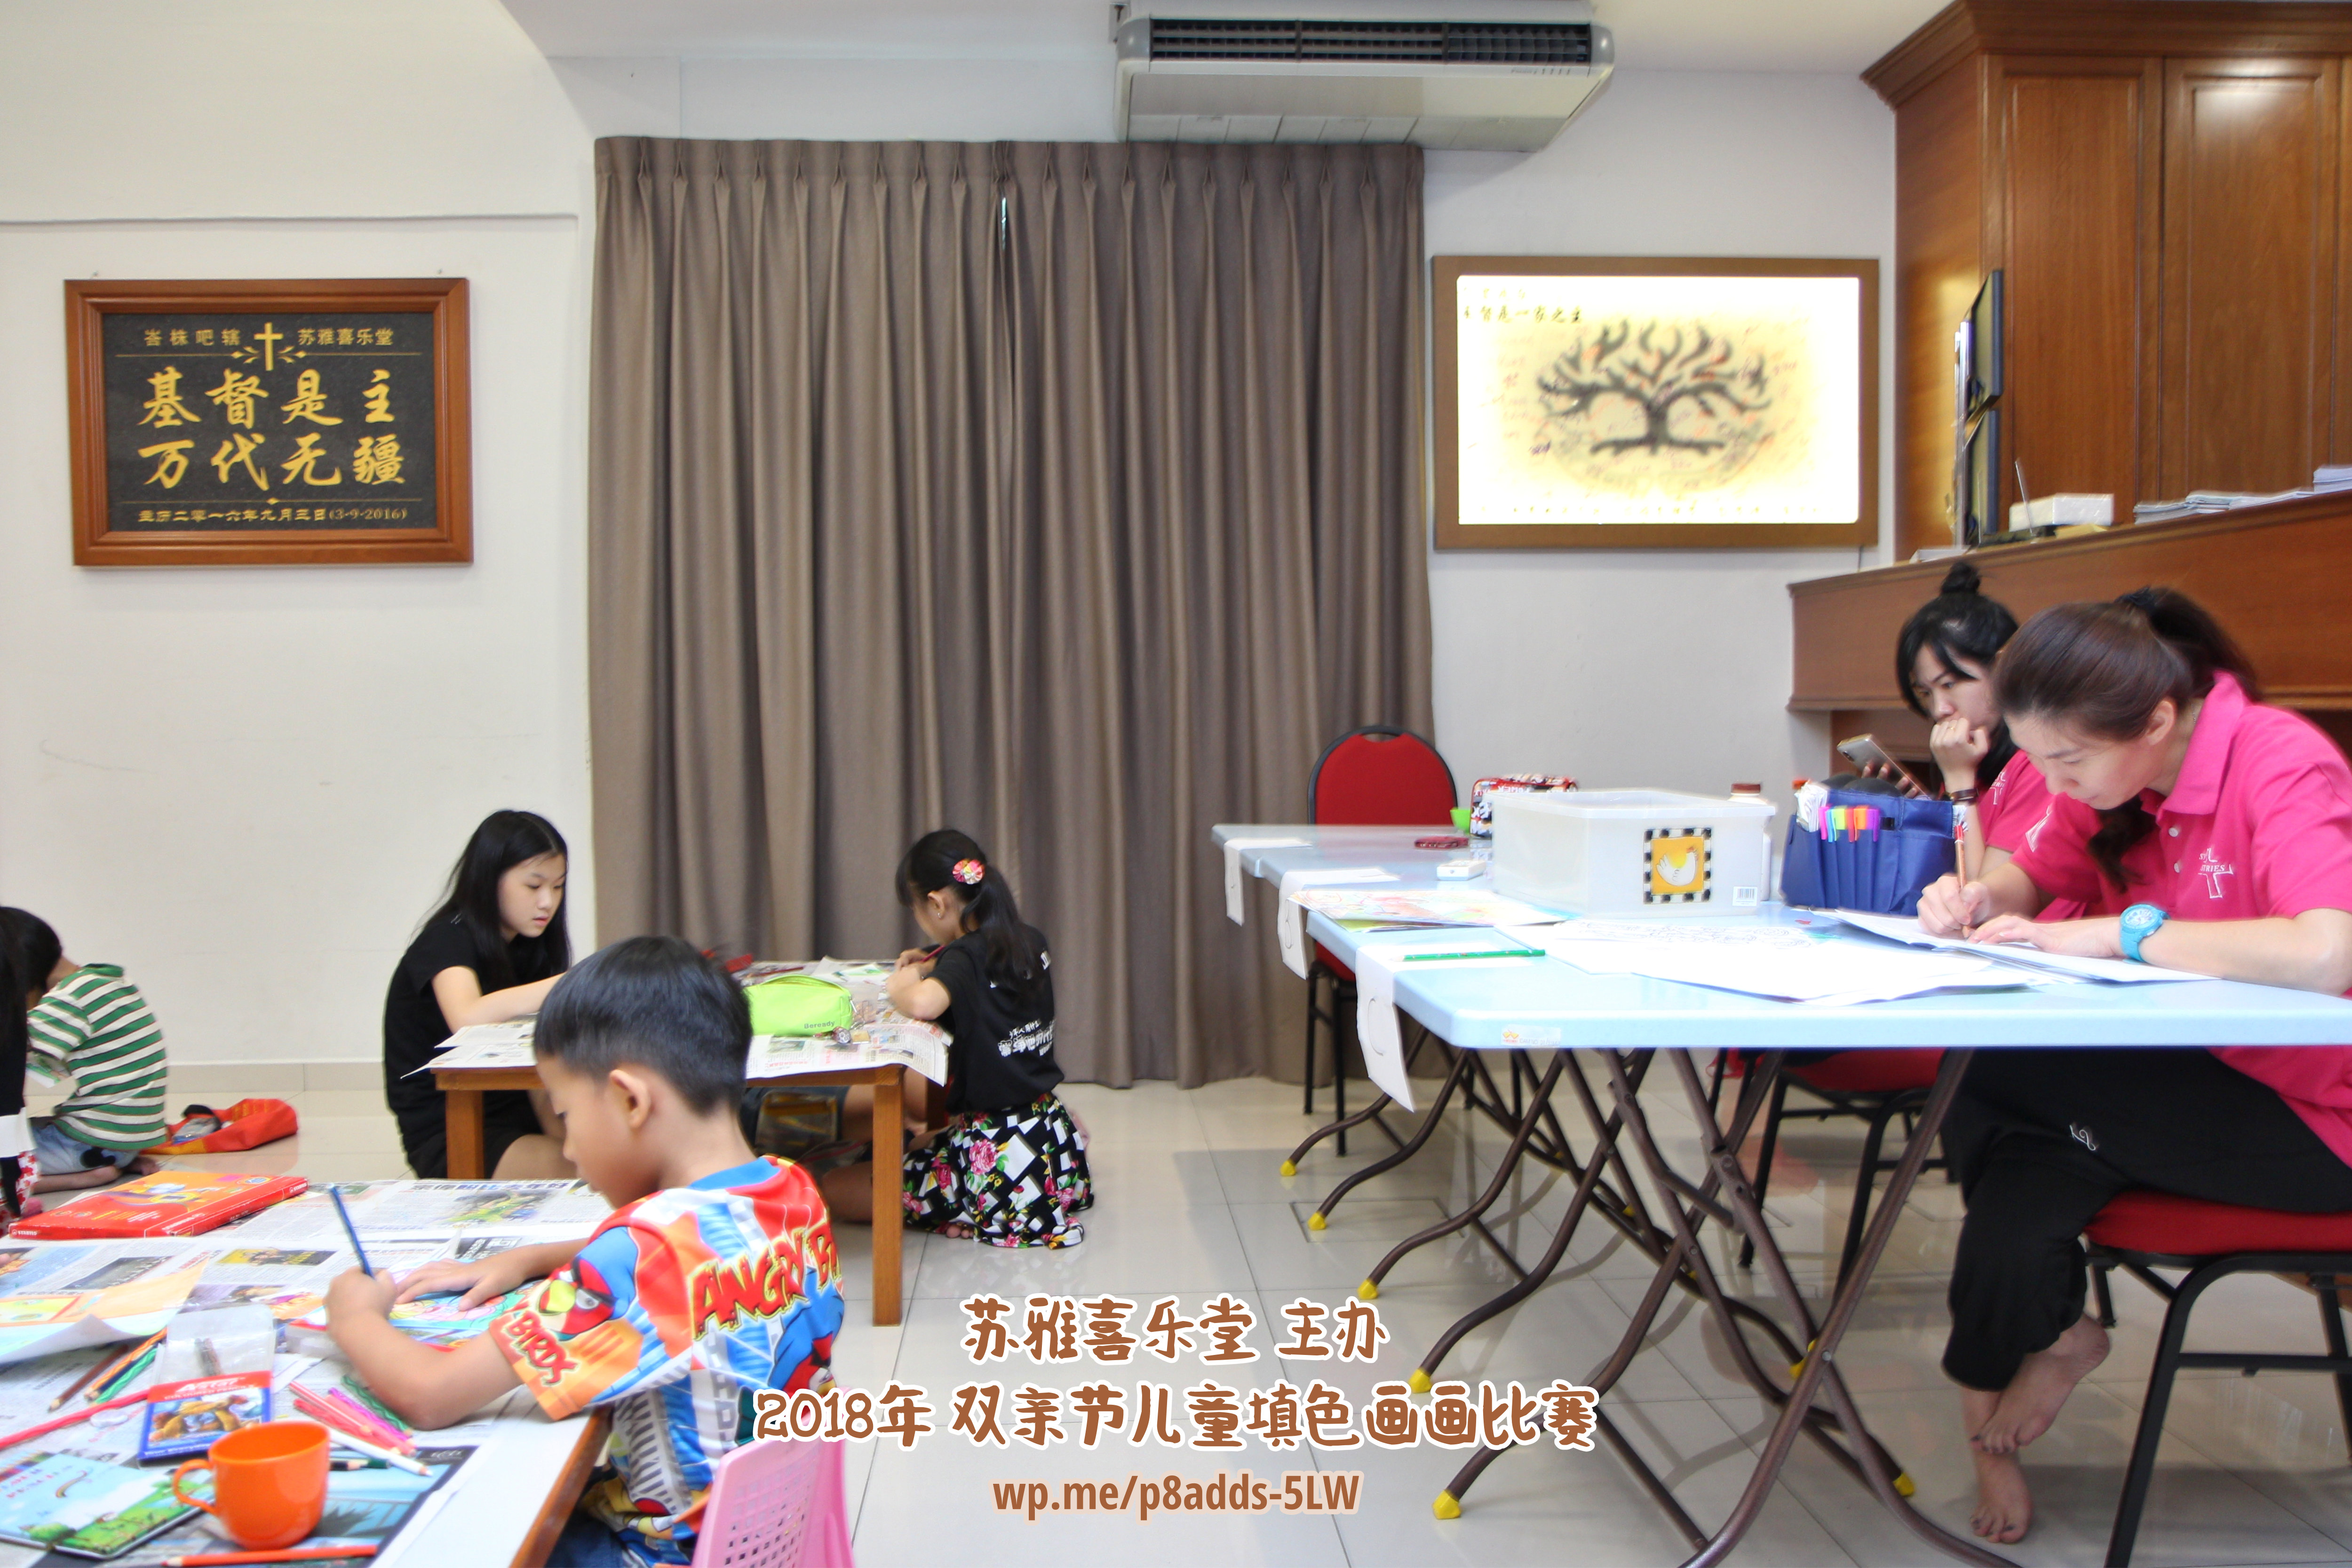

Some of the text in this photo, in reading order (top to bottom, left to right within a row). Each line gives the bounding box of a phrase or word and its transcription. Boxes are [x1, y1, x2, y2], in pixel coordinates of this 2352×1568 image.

[297, 327, 394, 346] 苏雅喜乐堂
[137, 365, 395, 429] 基督是主
[138, 433, 405, 491] 万代无疆
[804, 1021, 835, 1029] Beready
